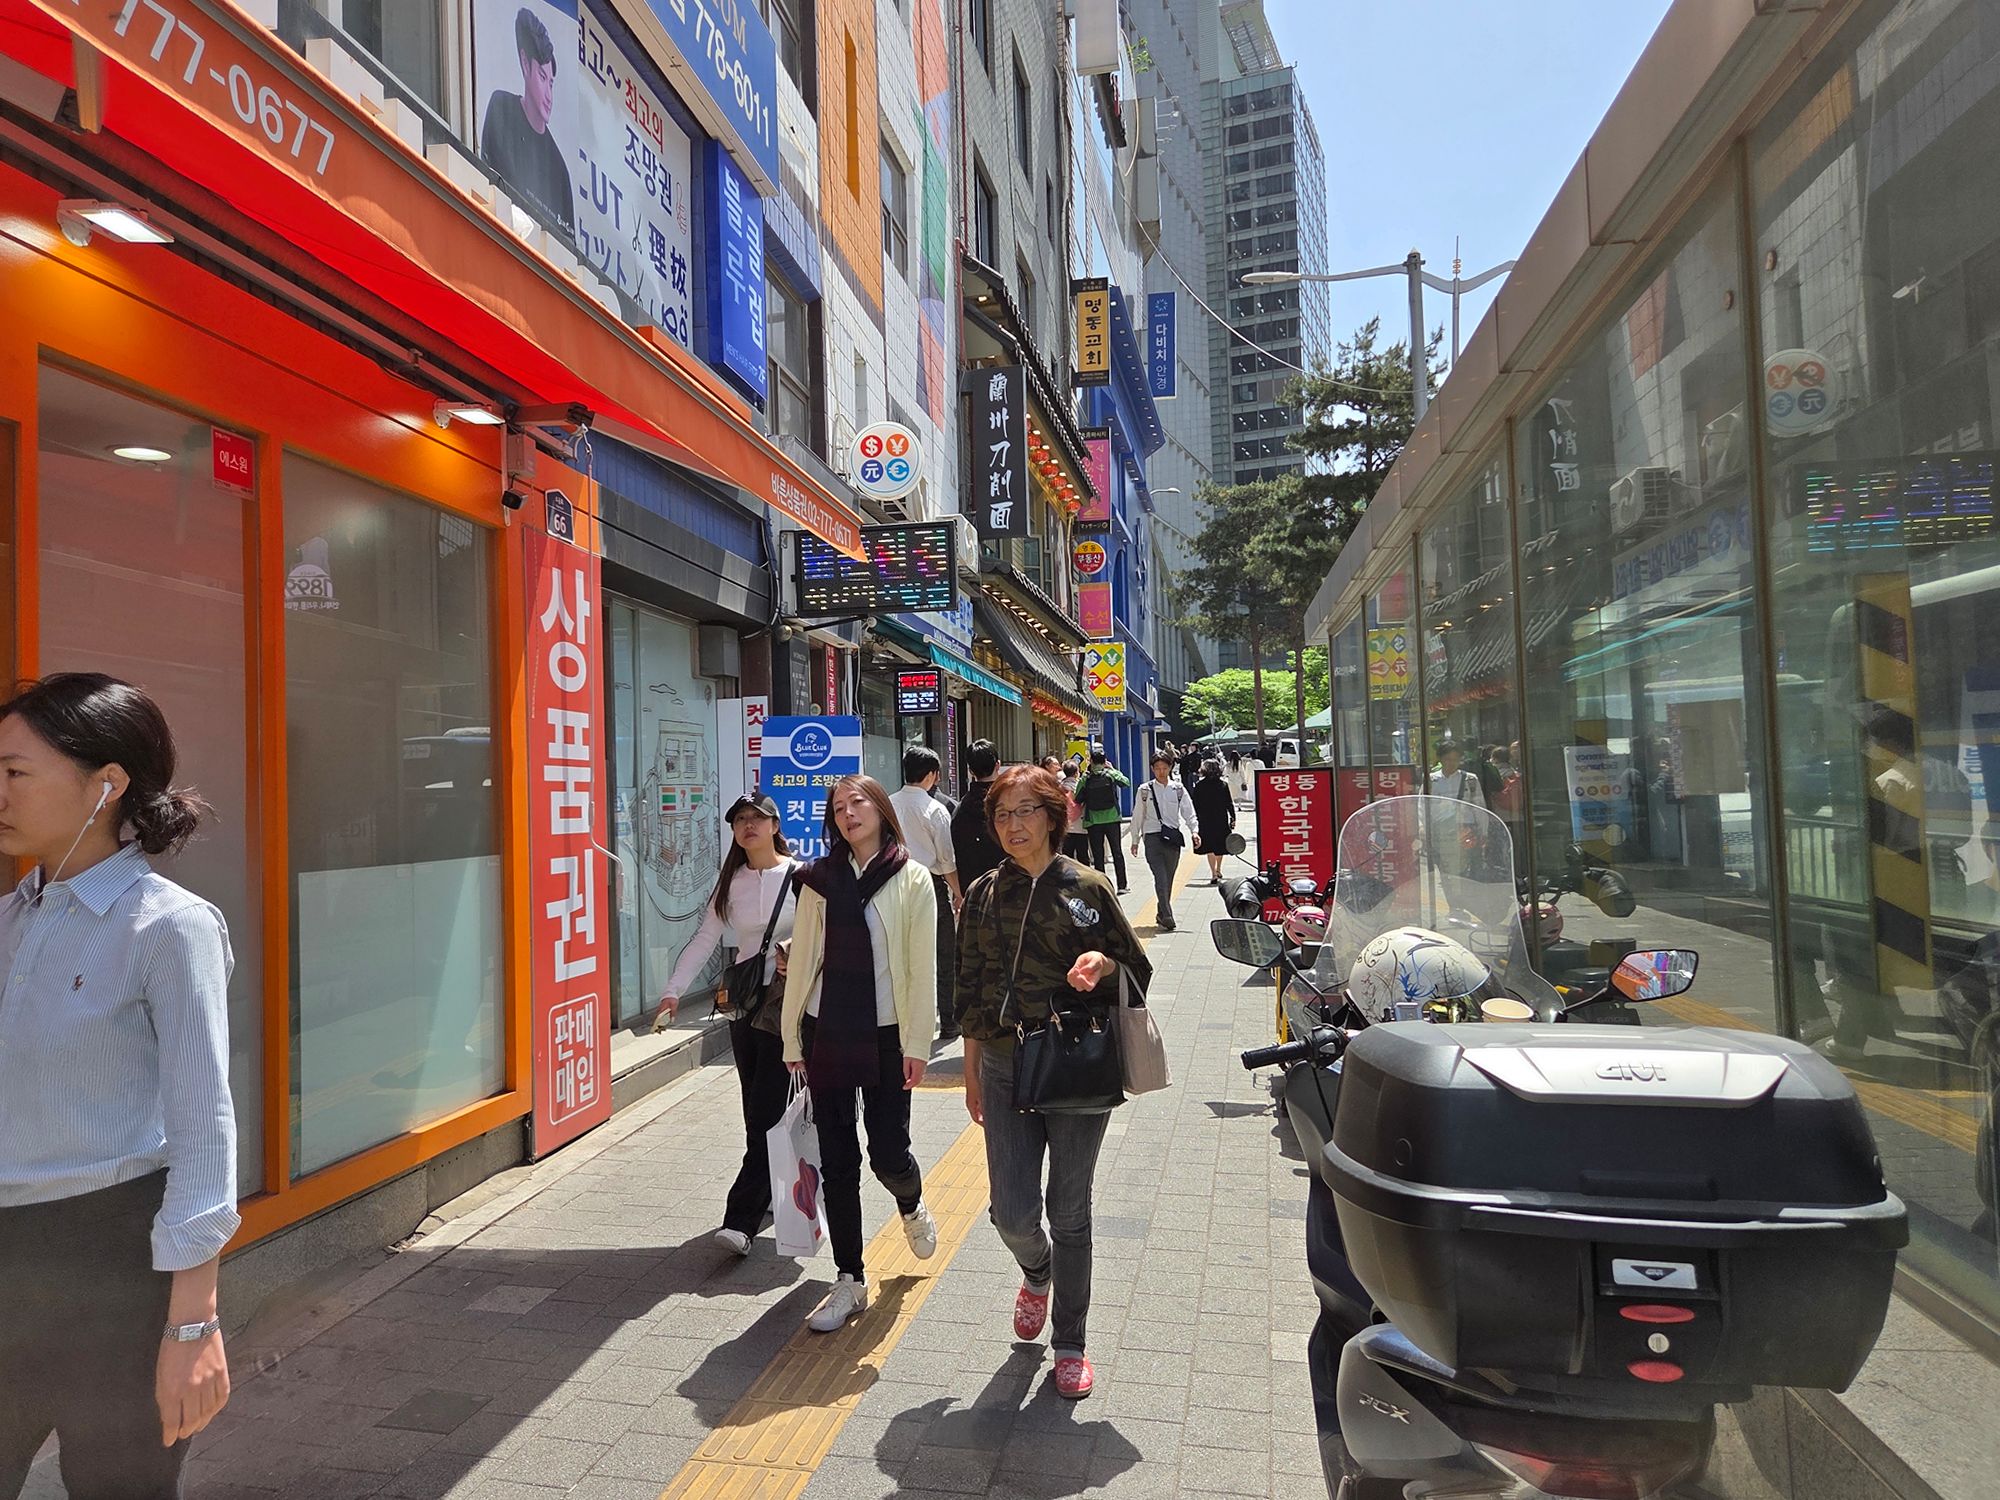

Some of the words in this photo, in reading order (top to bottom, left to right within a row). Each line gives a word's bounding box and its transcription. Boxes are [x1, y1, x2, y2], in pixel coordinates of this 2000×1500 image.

[624, 77, 664, 154] 최고의
[624, 124, 672, 216] 조망권
[1085, 298, 1102, 365] 명동교회
[1156, 323, 1168, 361] 다비치
[1156, 364, 1168, 390] 안경
[220, 450, 248, 474] 에스원
[989, 372, 1014, 530] 蘭州刀削面
[865, 463, 880, 479] 元
[554, 513, 567, 534] 66
[1078, 554, 1101, 563] 부동산
[1084, 610, 1109, 626] 수선
[540, 565, 598, 985] 상품권
[772, 774, 808, 787] 최고의
[1270, 774, 1318, 792] 명동
[555, 1000, 595, 1062] 판매
[556, 1053, 595, 1109] 매입
[1595, 1062, 1667, 1082] GIVI
